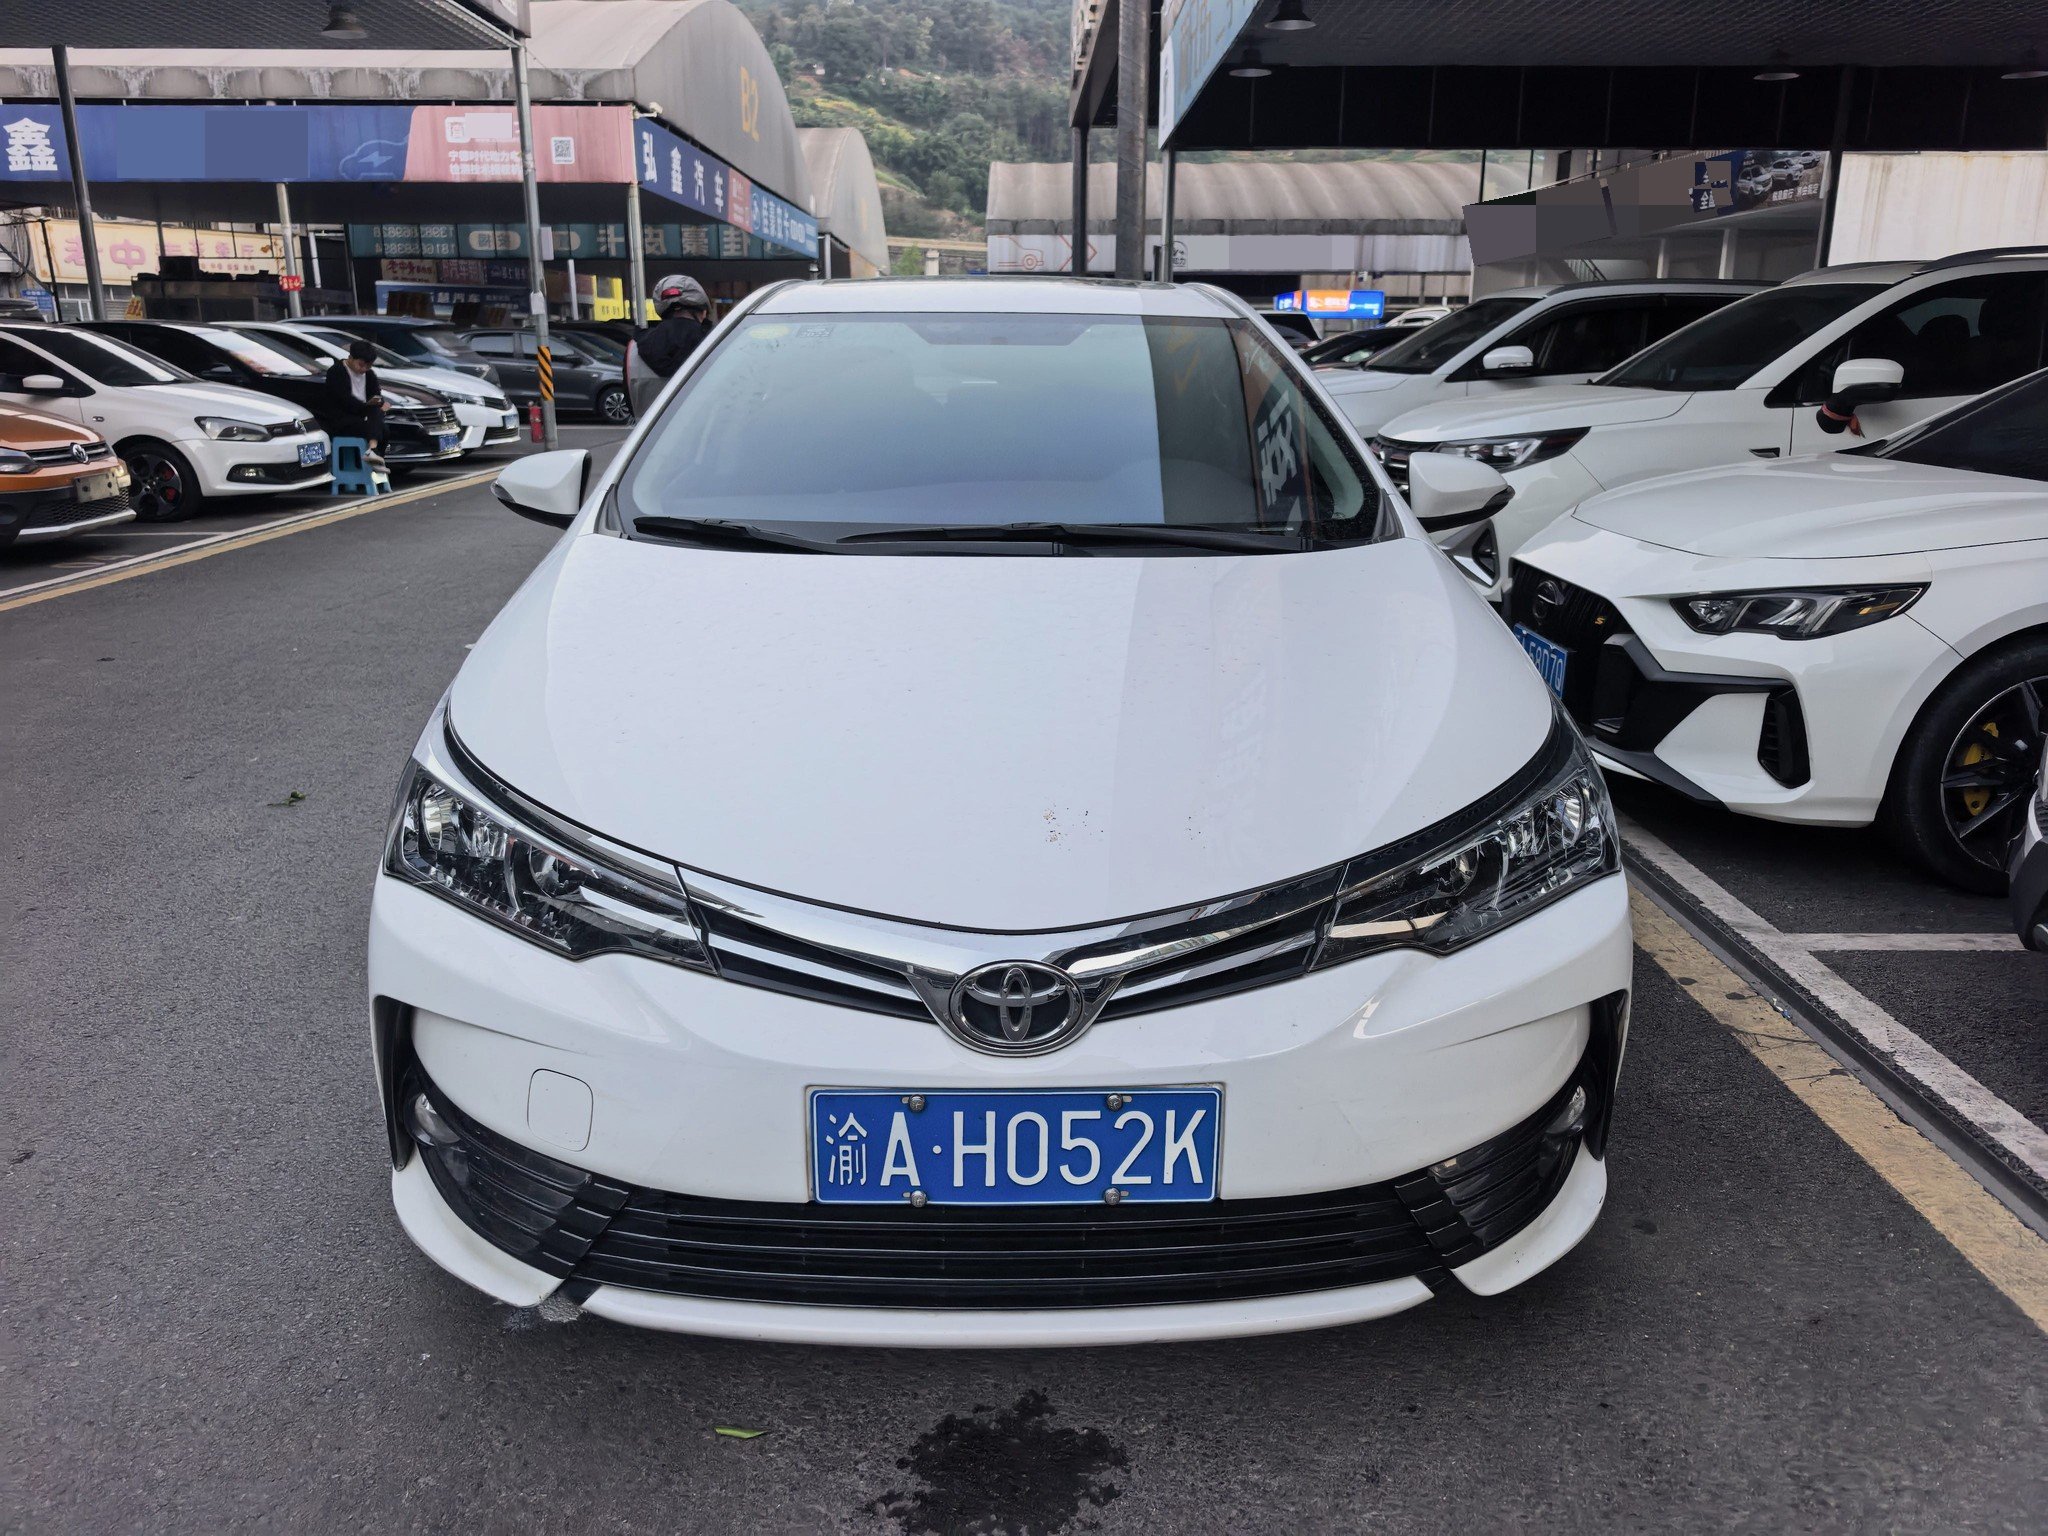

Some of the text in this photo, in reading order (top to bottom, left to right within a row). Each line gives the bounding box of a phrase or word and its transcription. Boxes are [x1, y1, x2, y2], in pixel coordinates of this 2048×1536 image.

[740, 65, 760, 143] B2
[3, 117, 58, 172] 鑫
[825, 1108, 1206, 1189] 渝A·H052K
